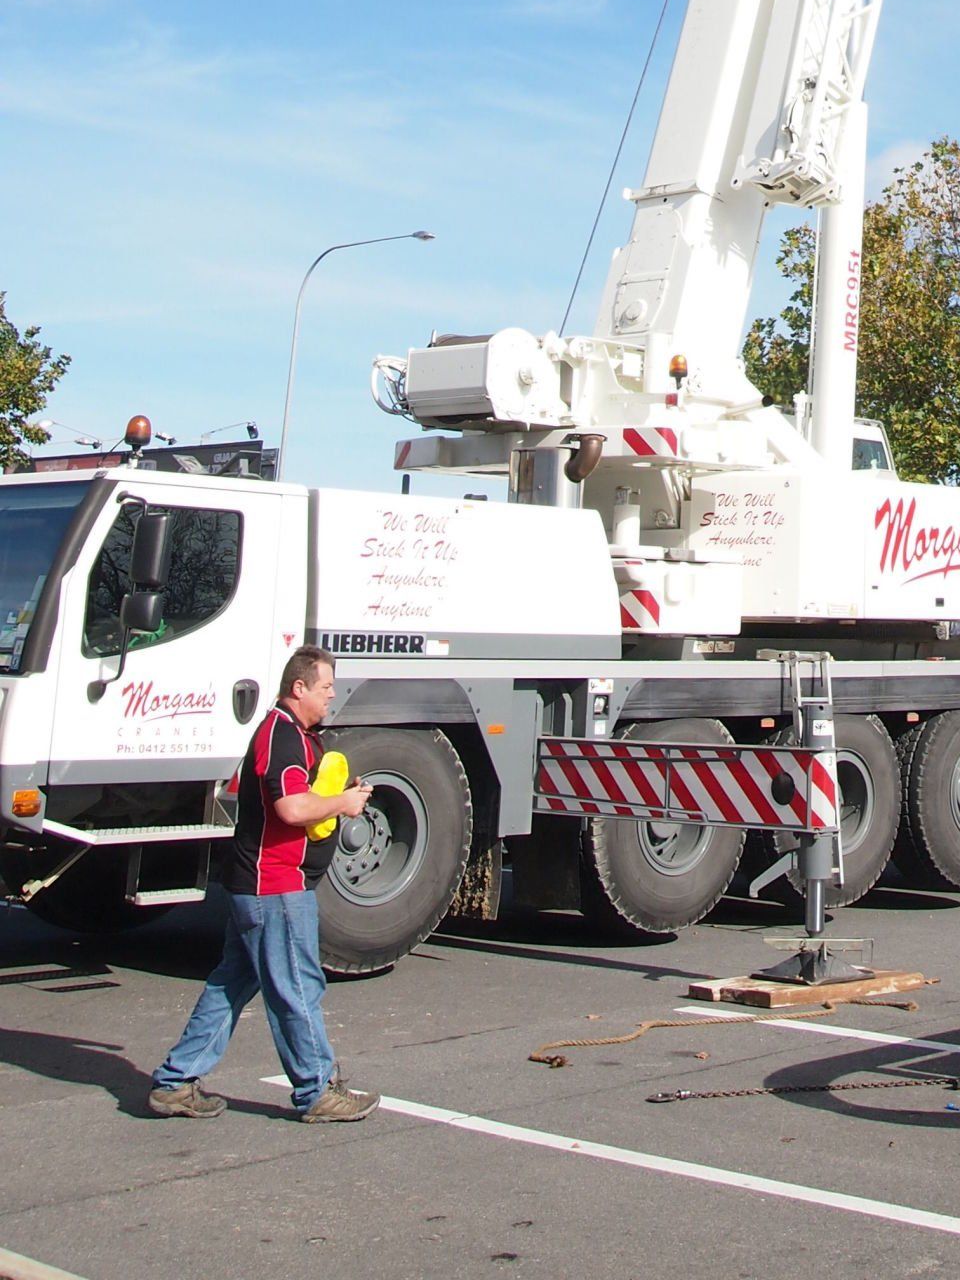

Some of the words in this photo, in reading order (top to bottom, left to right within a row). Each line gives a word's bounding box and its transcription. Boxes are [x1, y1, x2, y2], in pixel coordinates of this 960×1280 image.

[843, 249, 860, 352] MRC95t
[744, 493, 776, 507] Will
[414, 514, 451, 534] Will
[700, 512, 738, 527] Stick
[744, 510, 759, 526] It
[762, 510, 785, 530] Up
[360, 538, 405, 558] Stick
[412, 538, 429, 559] It
[434, 540, 458, 566] Up
[322, 634, 424, 653] LIEBHERR
[122, 680, 216, 719] Morgan's
[117, 726, 215, 737] CRANES
[116, 744, 134, 754] Ph:
[138, 744, 165, 754] 0412
[170, 744, 189, 754] 551
[194, 743, 213, 753] 791
